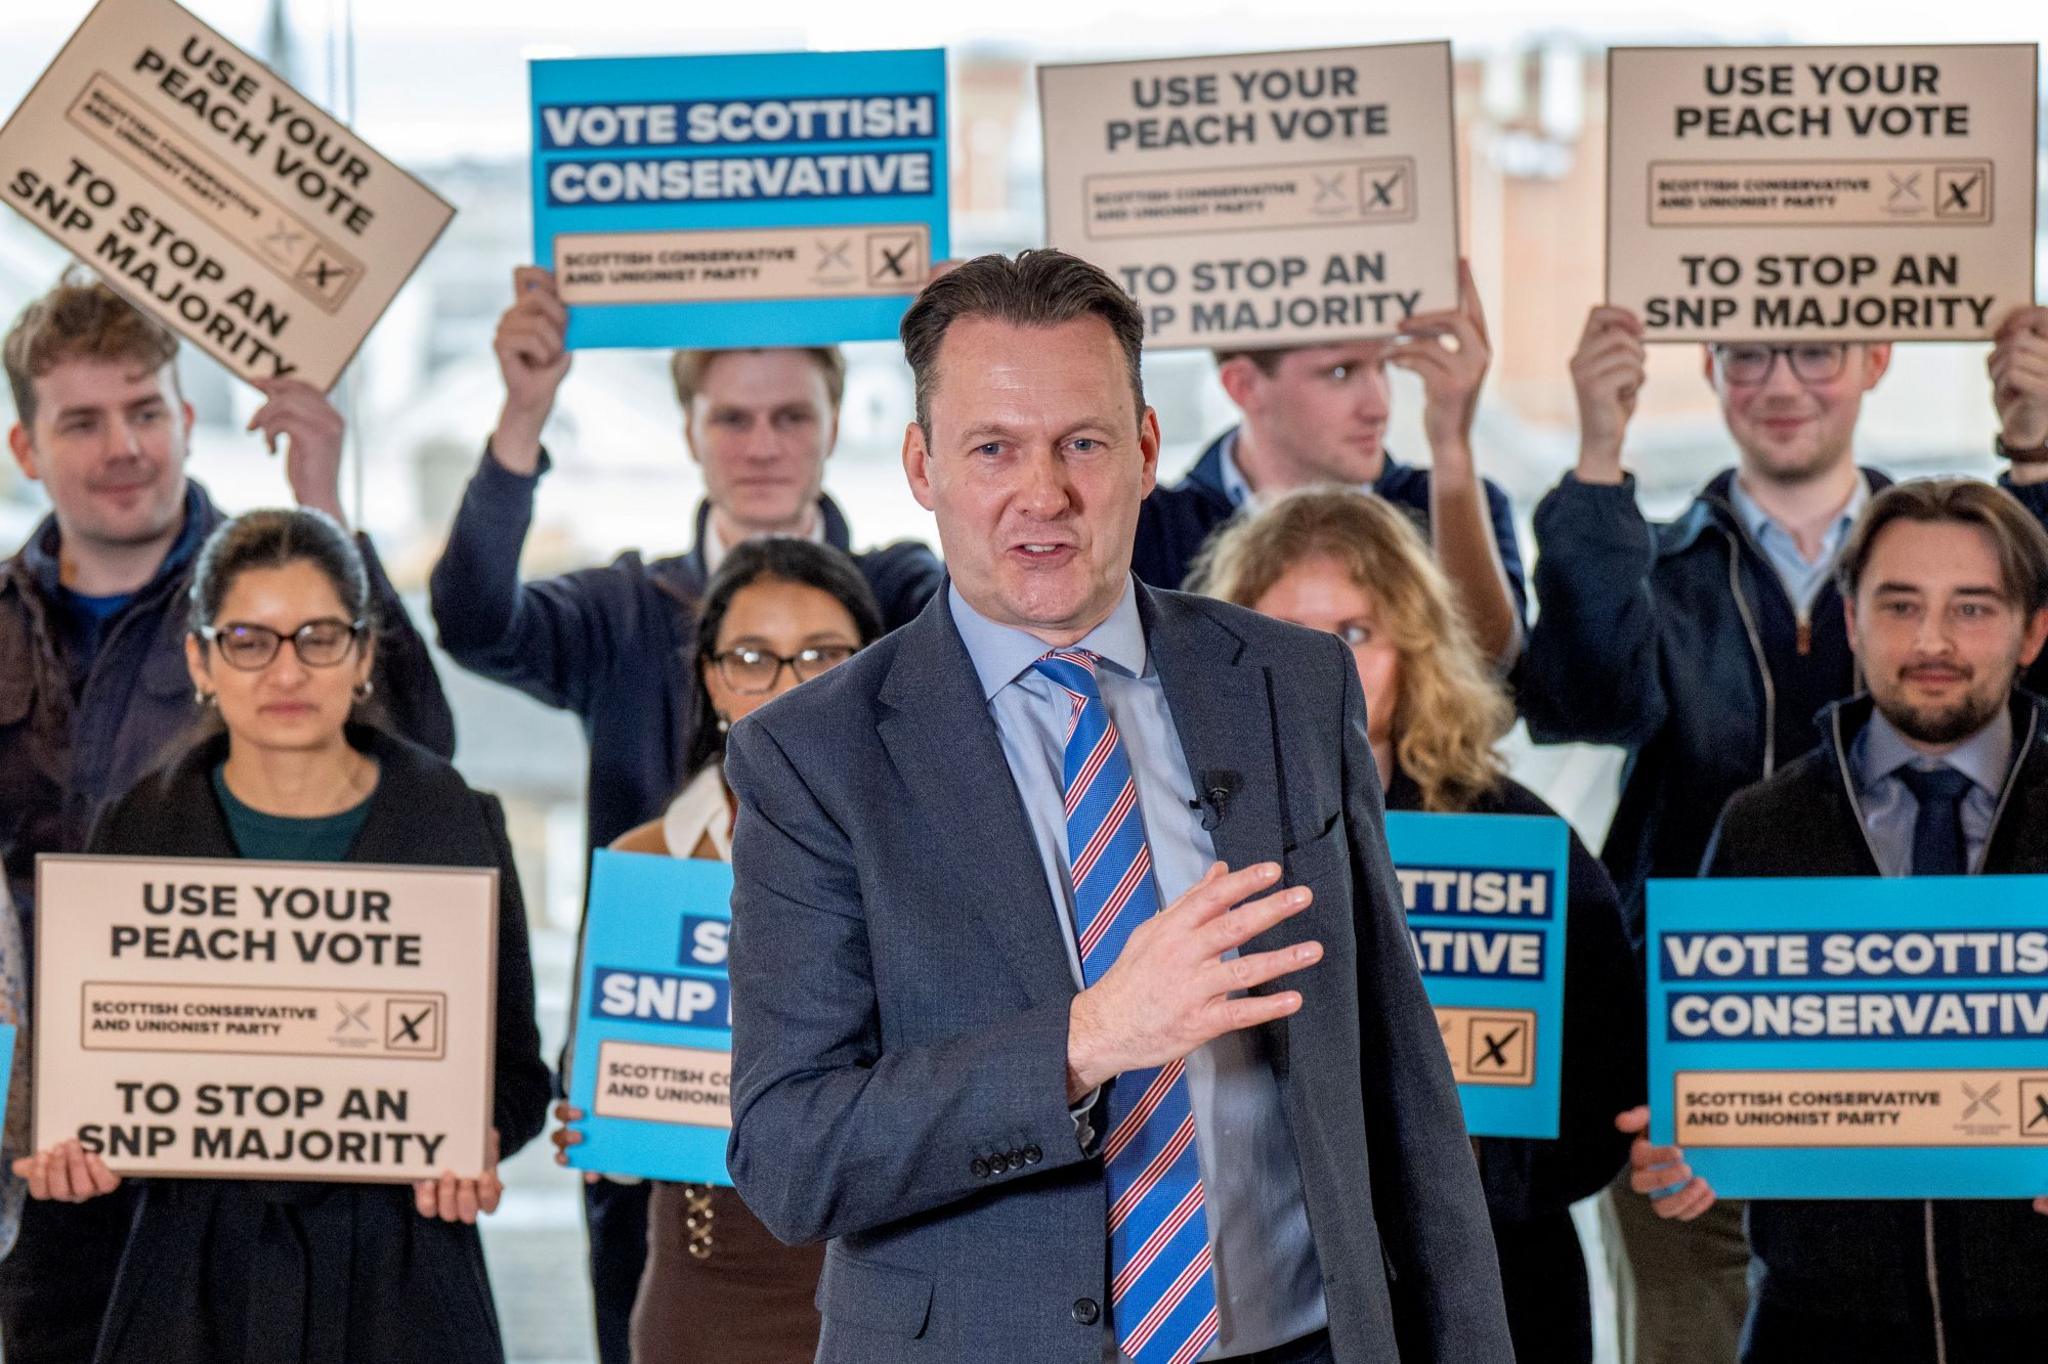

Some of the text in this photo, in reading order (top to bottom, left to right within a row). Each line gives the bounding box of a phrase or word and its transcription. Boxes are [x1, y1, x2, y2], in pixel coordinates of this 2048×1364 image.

[1132, 66, 1358, 109] USE YOUR
[1705, 63, 1940, 97] USE YOUR
[180, 34, 372, 188] USE YOUR
[543, 97, 932, 146] VOTE SCOTTISH
[1106, 104, 1389, 151] PEACH VOTE
[1675, 105, 1970, 138] PEACH VOTE
[133, 47, 375, 238] PEACH VOTE
[550, 154, 930, 203] CONSERVATIVE
[65, 157, 116, 208] TO
[121, 204, 226, 285] STOP
[226, 283, 291, 338] AN
[564, 247, 797, 267] SCOTTISH CONSERVATIVE
[8, 169, 299, 380] SNP MAJORITY
[564, 265, 760, 285] AND UNIONIST PARTY
[1119, 252, 1386, 295] TO STOP AN
[1681, 255, 1959, 288] TO STOP AN
[1191, 290, 1422, 335] MAJORITY
[1645, 296, 1996, 328] SNP MAJORITY
[143, 883, 392, 922] USE YOUR
[1396, 868, 1547, 915] TTISH
[110, 925, 422, 967] PEACH VOTE
[1664, 932, 2048, 977] VOTE SCOTTIS
[92, 1001, 317, 1020] SCOTTISH CONSERVATIVE
[600, 972, 717, 1022] SNP
[1672, 993, 2048, 1037] CONSERVATIV
[92, 1019, 282, 1037] AND UNIONIST PARTY
[609, 1061, 704, 1083] SCOTTISH
[115, 1082, 408, 1122] TO STOP AN
[607, 1082, 731, 1107] AND UNIONI
[1686, 1091, 1941, 1107] SCOTTISH CONSERVATIVE
[1686, 1111, 1900, 1126] AND UNIONIST PARTY
[78, 1124, 447, 1165] SNP MAJORITY
